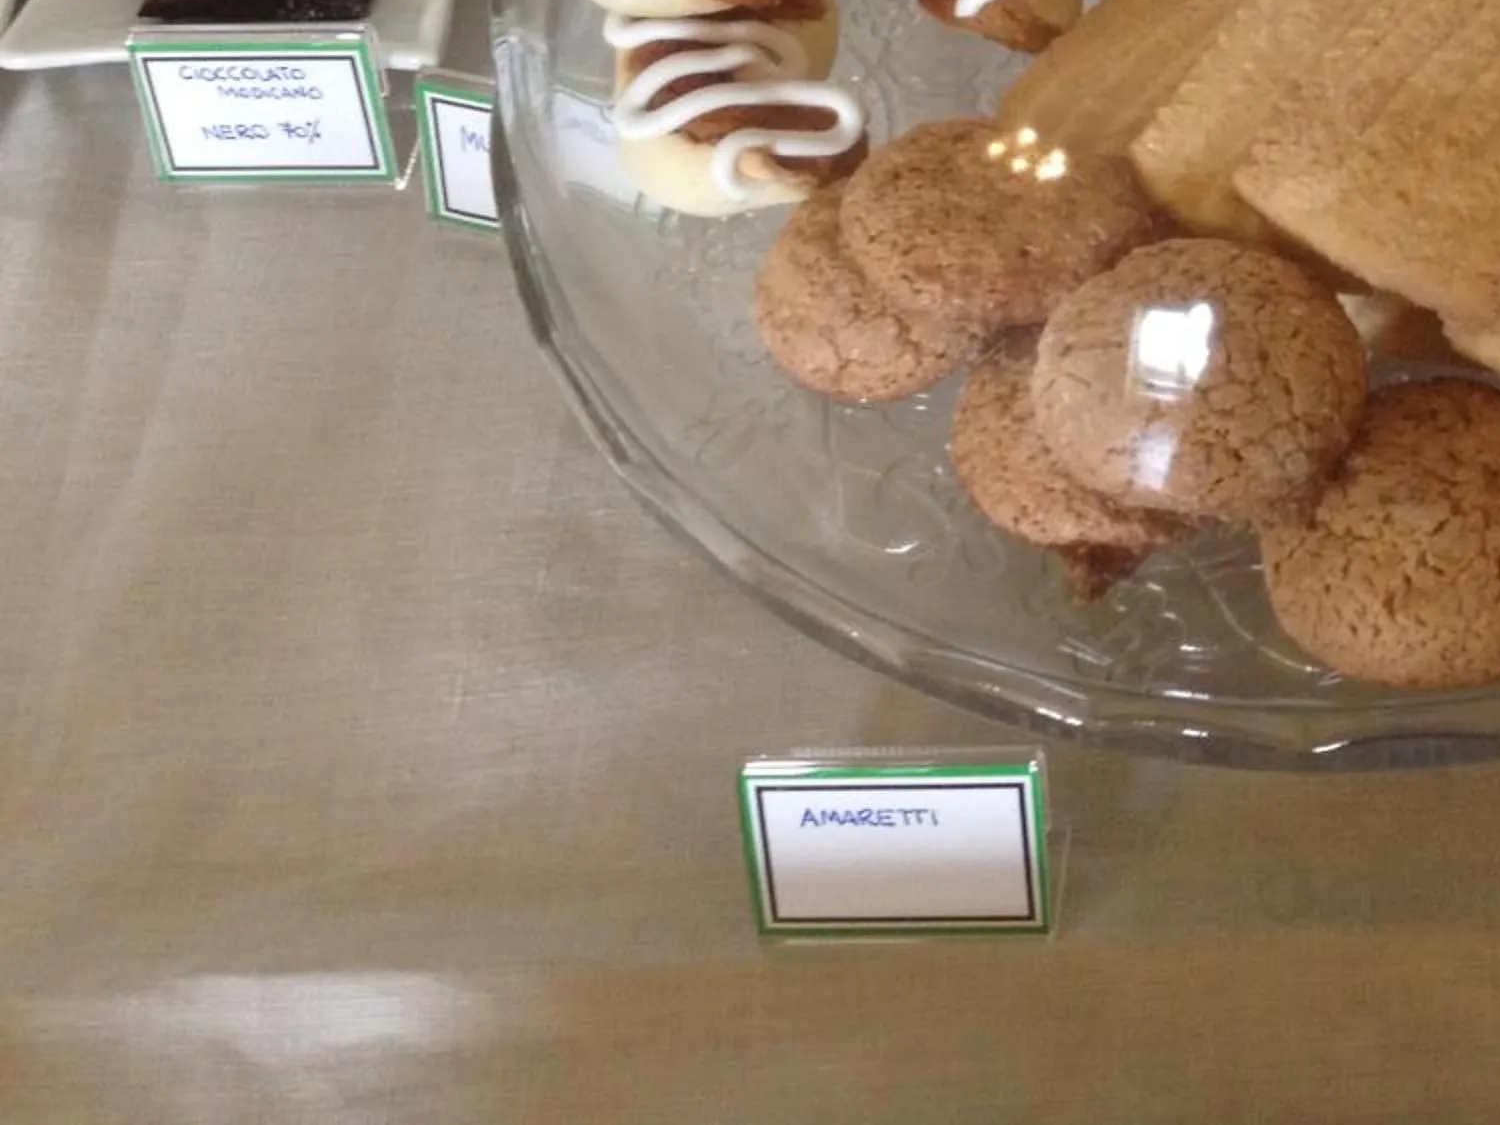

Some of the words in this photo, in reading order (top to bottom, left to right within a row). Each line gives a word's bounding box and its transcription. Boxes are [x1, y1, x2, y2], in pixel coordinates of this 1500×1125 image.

[178, 65, 307, 81] CIOCCOLATO
[201, 124, 271, 140] NERO
[277, 119, 322, 144] 70%
[800, 807, 940, 827] AMARETTI
